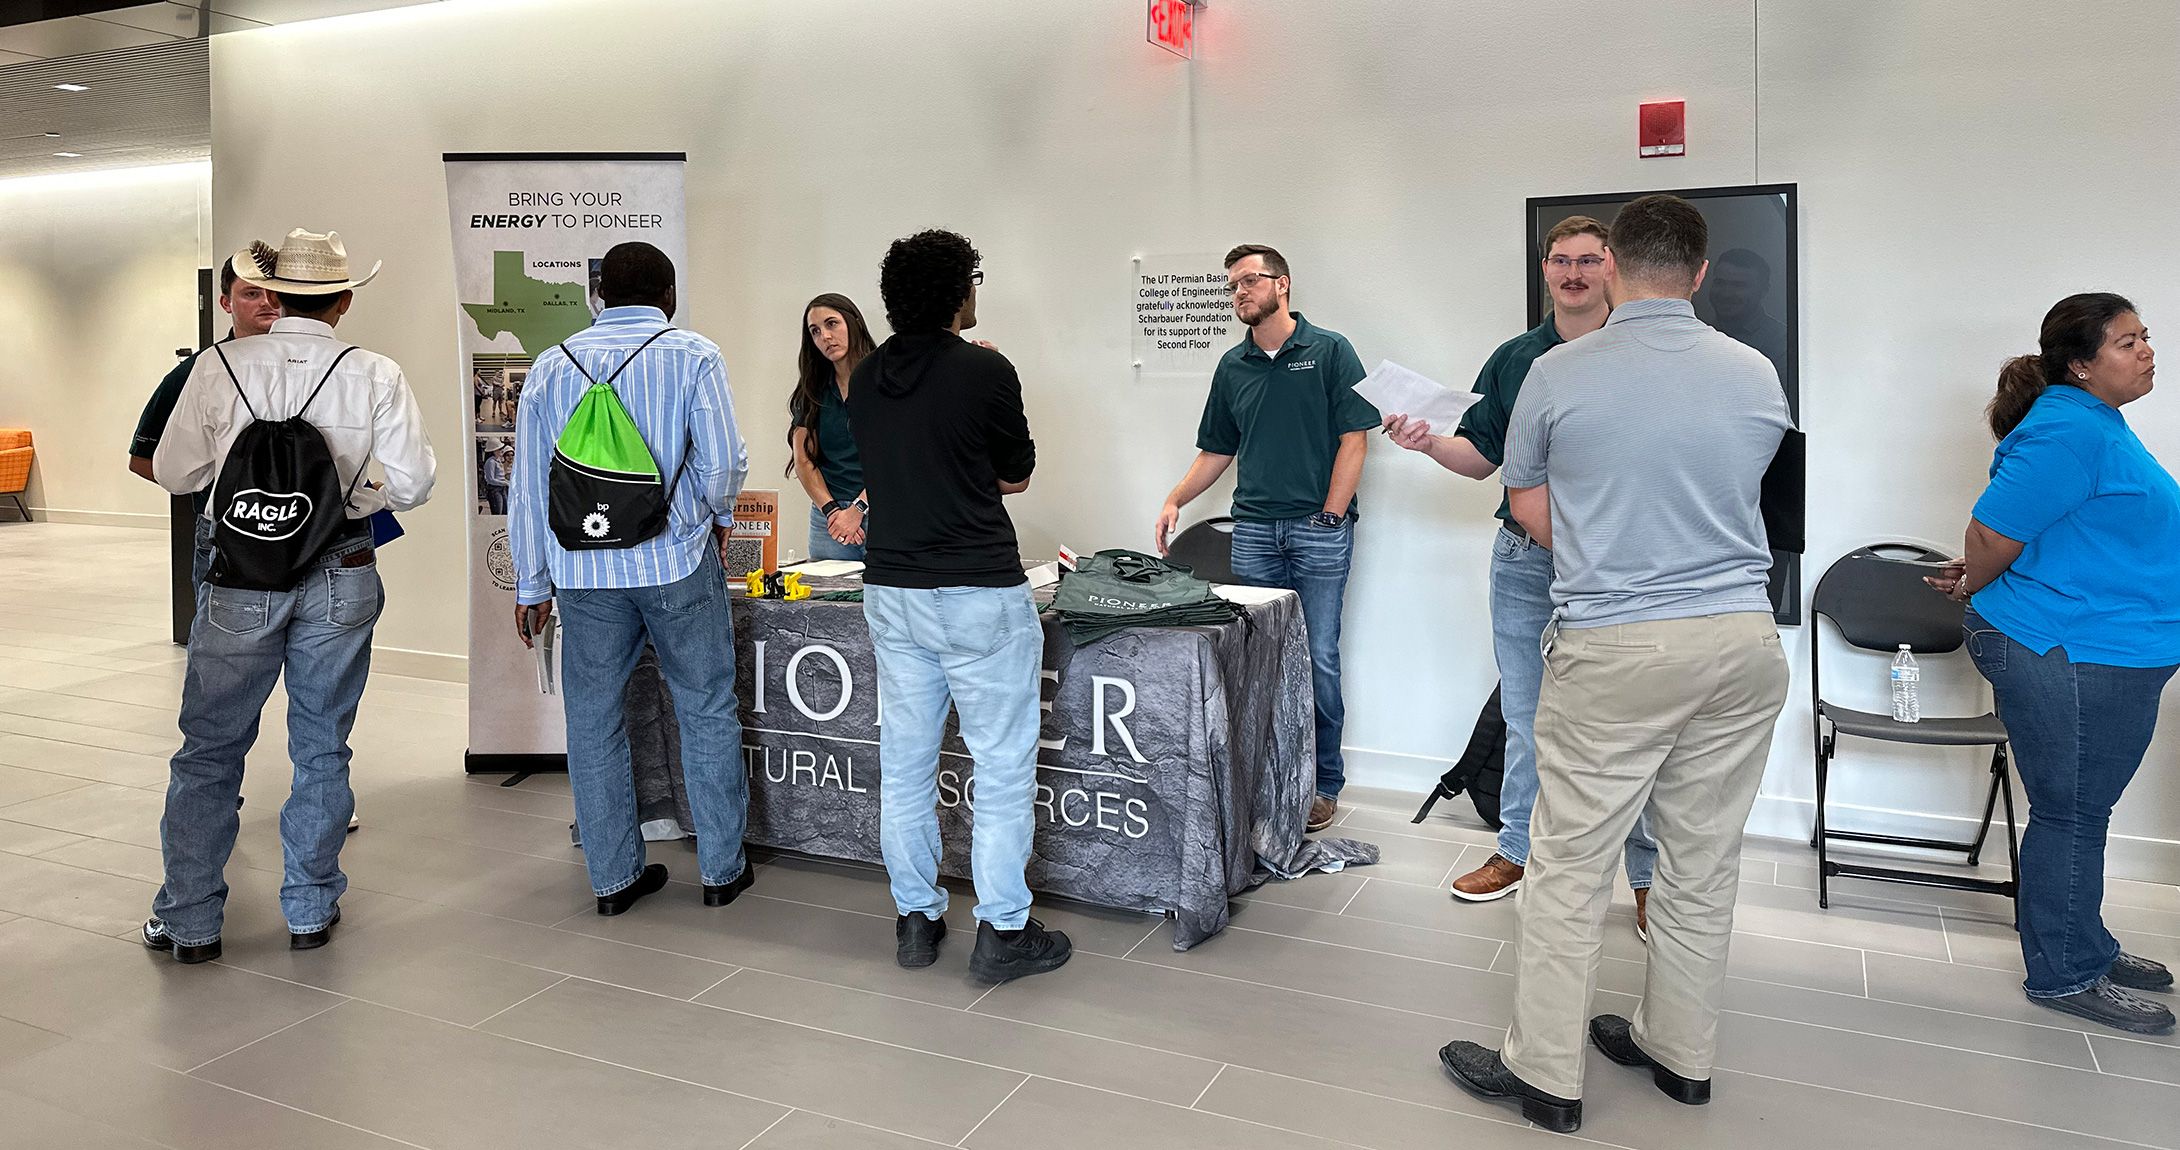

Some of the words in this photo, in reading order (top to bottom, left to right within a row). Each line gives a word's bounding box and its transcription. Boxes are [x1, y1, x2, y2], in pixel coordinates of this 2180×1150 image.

[509, 192, 563, 206] BRING
[570, 192, 622, 206] YOUR
[470, 214, 547, 228] ENERGY
[552, 214, 576, 228] TO
[583, 214, 662, 228] PIONEER
[1141, 275, 1156, 284] The
[1158, 275, 1169, 284] UT
[1171, 274, 1204, 284] Permian
[1206, 273, 1229, 283] Basin
[1139, 288, 1169, 298] College
[1172, 288, 1180, 297] of
[1136, 301, 1174, 312] gratefully
[1176, 300, 1234, 311] acknowledges
[1138, 314, 1183, 324] Scharbauer
[1185, 313, 1232, 323] Foundation
[1144, 327, 1155, 336] for
[1157, 327, 1167, 336] its
[1169, 327, 1201, 338] support
[1202, 326, 1211, 335] of
[1213, 326, 1227, 335] the
[1157, 340, 1187, 349] Second
[1189, 339, 1211, 349] Floor
[1287, 360, 1316, 368] PIONEER
[233, 499, 297, 521] RAGLE
[597, 502, 610, 512] bp
[257, 523, 277, 532] INC.
[491, 528, 506, 537] SCAN
[1088, 595, 1173, 609] PIONEER
[742, 744, 867, 793] TURAL
